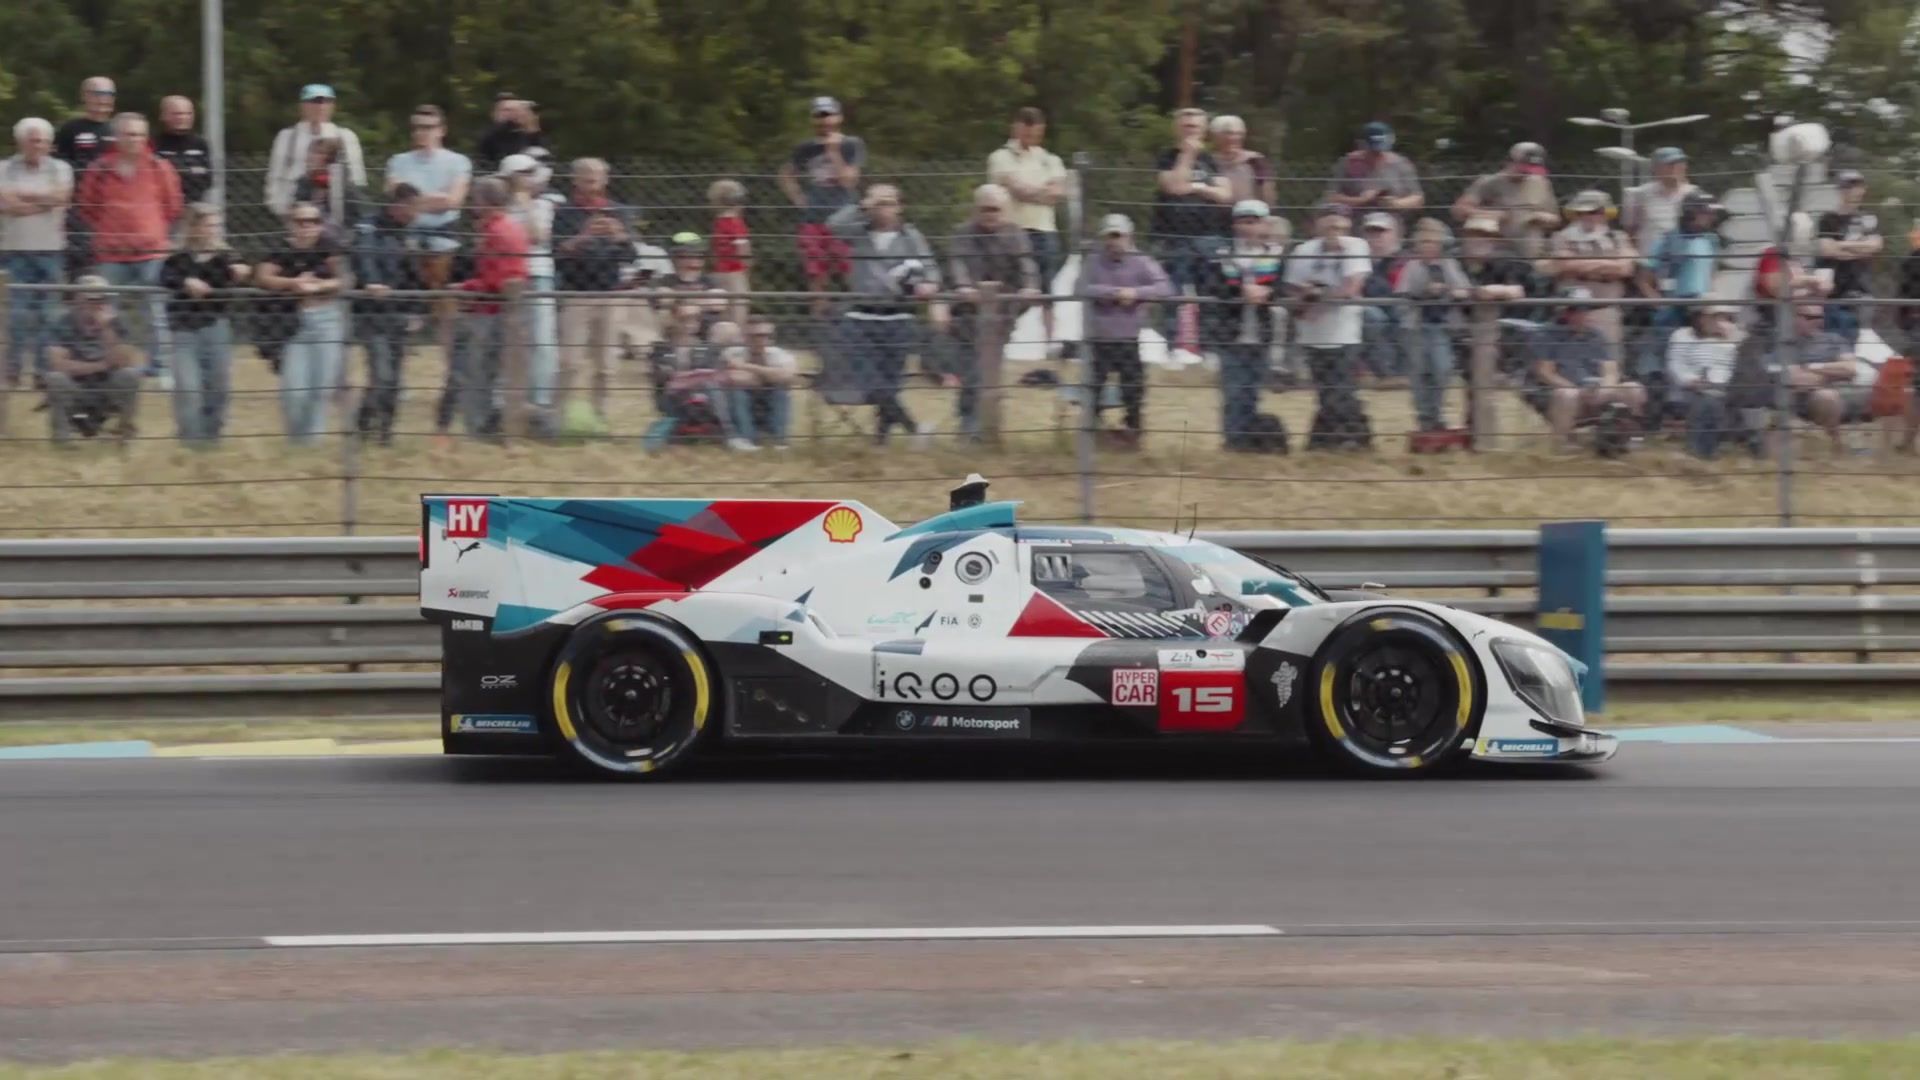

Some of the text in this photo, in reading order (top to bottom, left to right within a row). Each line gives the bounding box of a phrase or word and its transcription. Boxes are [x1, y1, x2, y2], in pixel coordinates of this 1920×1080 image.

[448, 504, 486, 532] HY
[481, 675, 517, 684] OZ
[1115, 671, 1156, 684] HYPER
[1115, 684, 1156, 703] CAR
[1171, 687, 1233, 712] 15
[475, 720, 532, 728] MICHELIN
[952, 716, 1020, 730] Motorsport
[1501, 743, 1554, 752] MICHELIN
